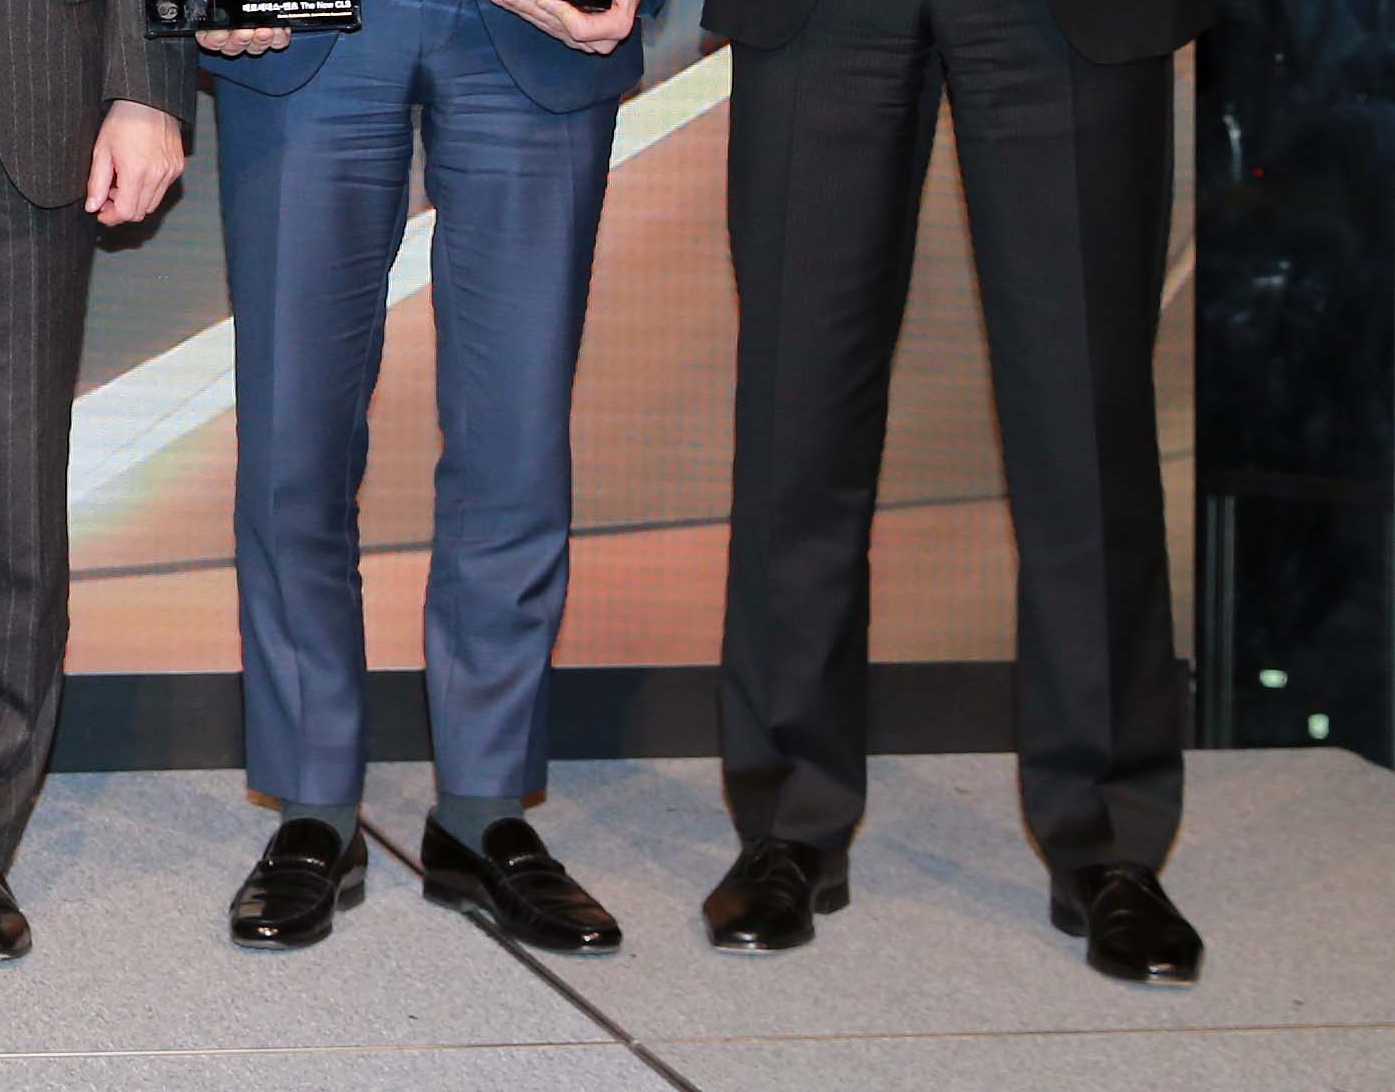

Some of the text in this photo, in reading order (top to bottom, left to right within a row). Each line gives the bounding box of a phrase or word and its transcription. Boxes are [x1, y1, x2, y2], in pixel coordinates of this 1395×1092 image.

[300, 1, 315, 9] The
[316, 1, 334, 9] New
[334, 0, 351, 8] CLS
